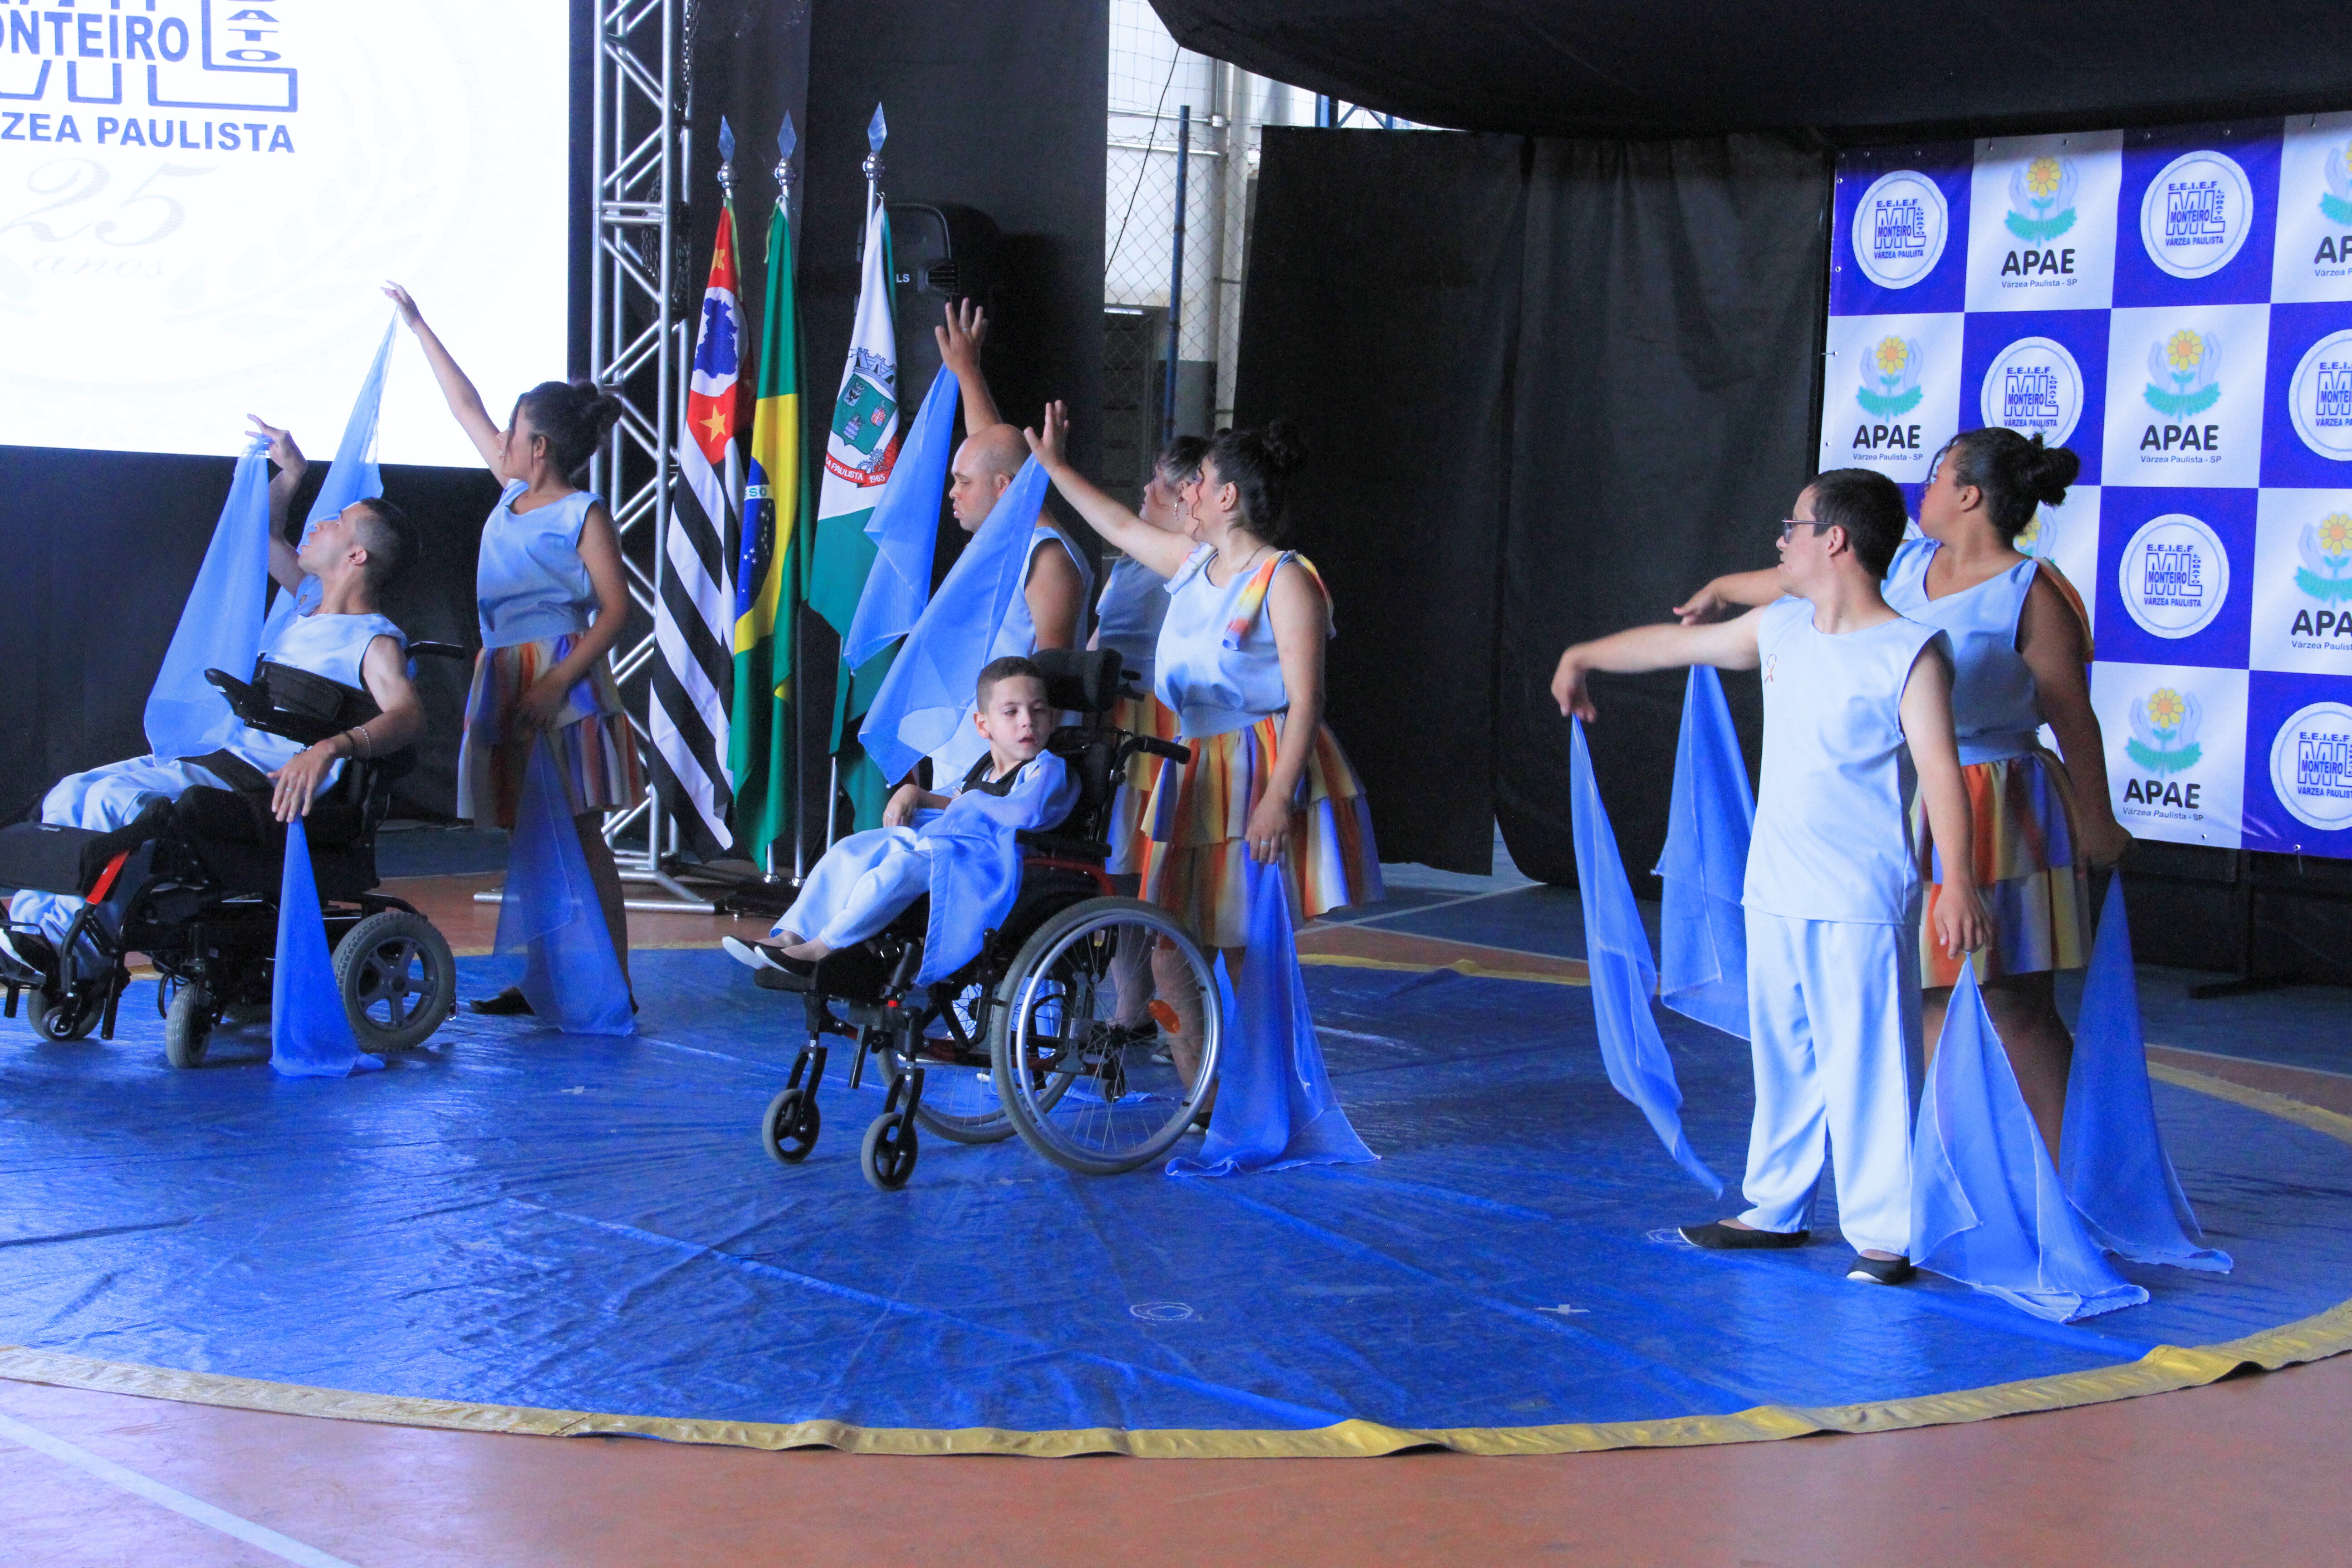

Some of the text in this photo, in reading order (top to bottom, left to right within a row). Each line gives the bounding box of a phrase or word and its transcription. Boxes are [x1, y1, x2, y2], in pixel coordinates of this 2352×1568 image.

[0, 10, 190, 62] NTEIRO
[225, 0, 281, 62] ATO
[1, 112, 295, 153] ZEA PAULISTA
[0, 158, 220, 246] 25
[2214, 190, 2225, 220] LOBATO
[2171, 210, 2210, 223] MONTEIRO
[1878, 225, 1911, 237] MONTEIRO
[2166, 236, 2223, 246] VÁRZEA PAULISTA
[1874, 250, 1923, 259] VÁRZEA PAULISTA
[33, 255, 164, 278] anos
[2001, 249, 2075, 276] APAE
[2048, 375, 2057, 404] LOBATO
[2008, 393, 2044, 405] MONTEIRO
[2004, 418, 2027, 426] VÁRZEA
[2316, 417, 2342, 426] VÁRZEA
[1852, 425, 1921, 449] APAE
[2140, 425, 2219, 451] APAE
[831, 462, 863, 481] PAULISTA
[868, 474, 885, 483] 1965
[745, 487, 766, 497] SO
[2191, 554, 2201, 583] LOBATO
[2148, 571, 2186, 584] MONTEIRO
[2144, 597, 2201, 607] VÁRZEA PAULISTA
[2292, 640, 2321, 649] Várzea
[2302, 760, 2343, 774] MONTEIRO
[2123, 778, 2200, 809] APAE
[2123, 807, 2151, 816] Várzea
[2154, 810, 2186, 819] Paulista
